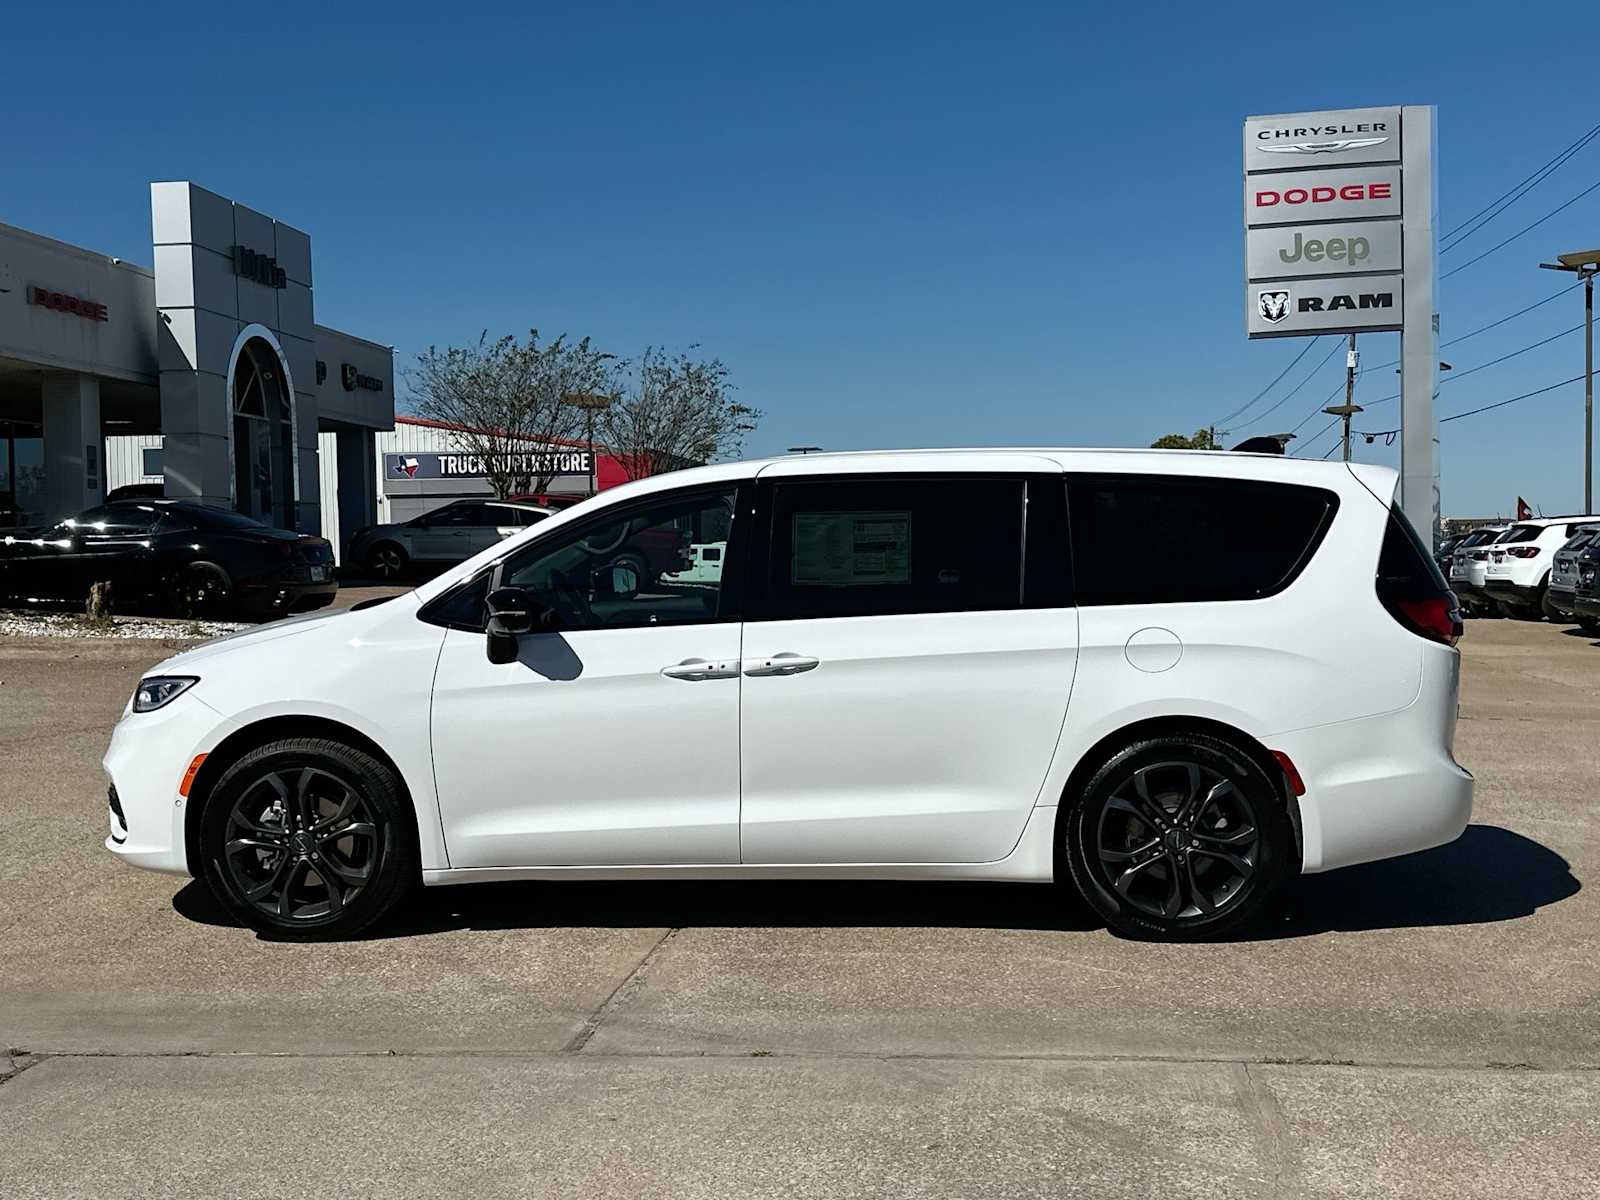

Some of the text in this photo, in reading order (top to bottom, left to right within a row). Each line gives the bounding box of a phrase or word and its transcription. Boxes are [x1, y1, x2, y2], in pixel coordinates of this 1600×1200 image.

[1257, 122, 1387, 140] CHRYSLER
[1256, 183, 1391, 207] DODGE
[1279, 233, 1370, 265] Jeep
[1298, 293, 1393, 312] RAM
[438, 455, 488, 474] TRUCK
